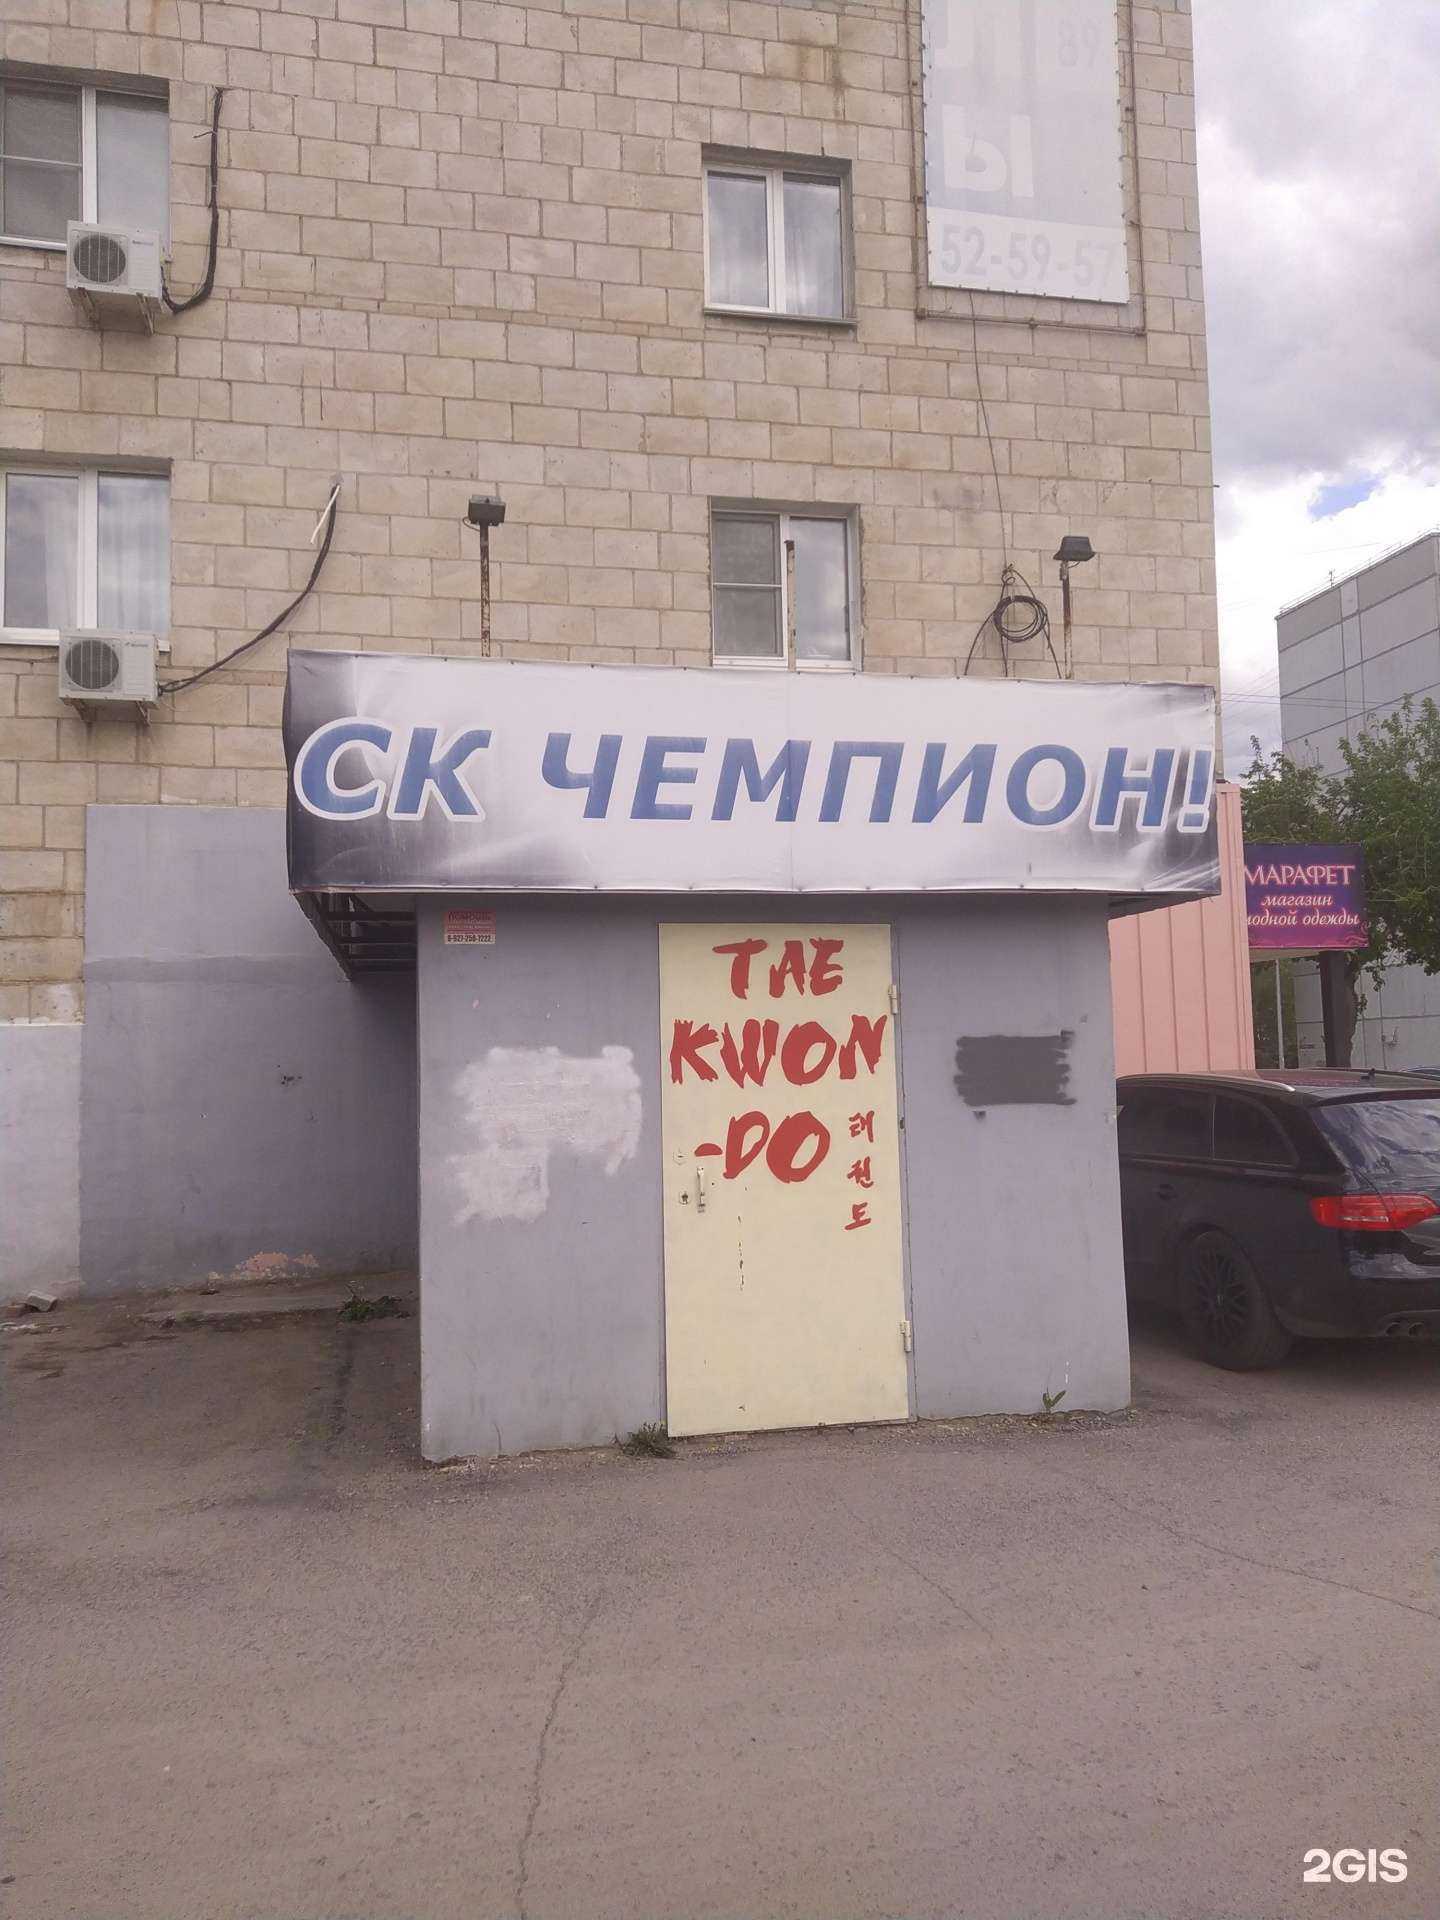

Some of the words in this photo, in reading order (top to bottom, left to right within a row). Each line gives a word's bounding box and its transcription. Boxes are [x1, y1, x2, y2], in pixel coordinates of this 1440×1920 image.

[940, 223, 1120, 288] 52-59-57
[296, 718, 494, 820] СК
[540, 731, 1214, 830] ЧЕМПИОН!
[1244, 864, 1356, 885] МАРАФЕТ
[1261, 895, 1335, 906] магазин
[1303, 908, 1360, 925] одежды
[712, 938, 844, 1000] TAE
[669, 1014, 888, 1089] KWON
[694, 1110, 831, 1183] -DO
